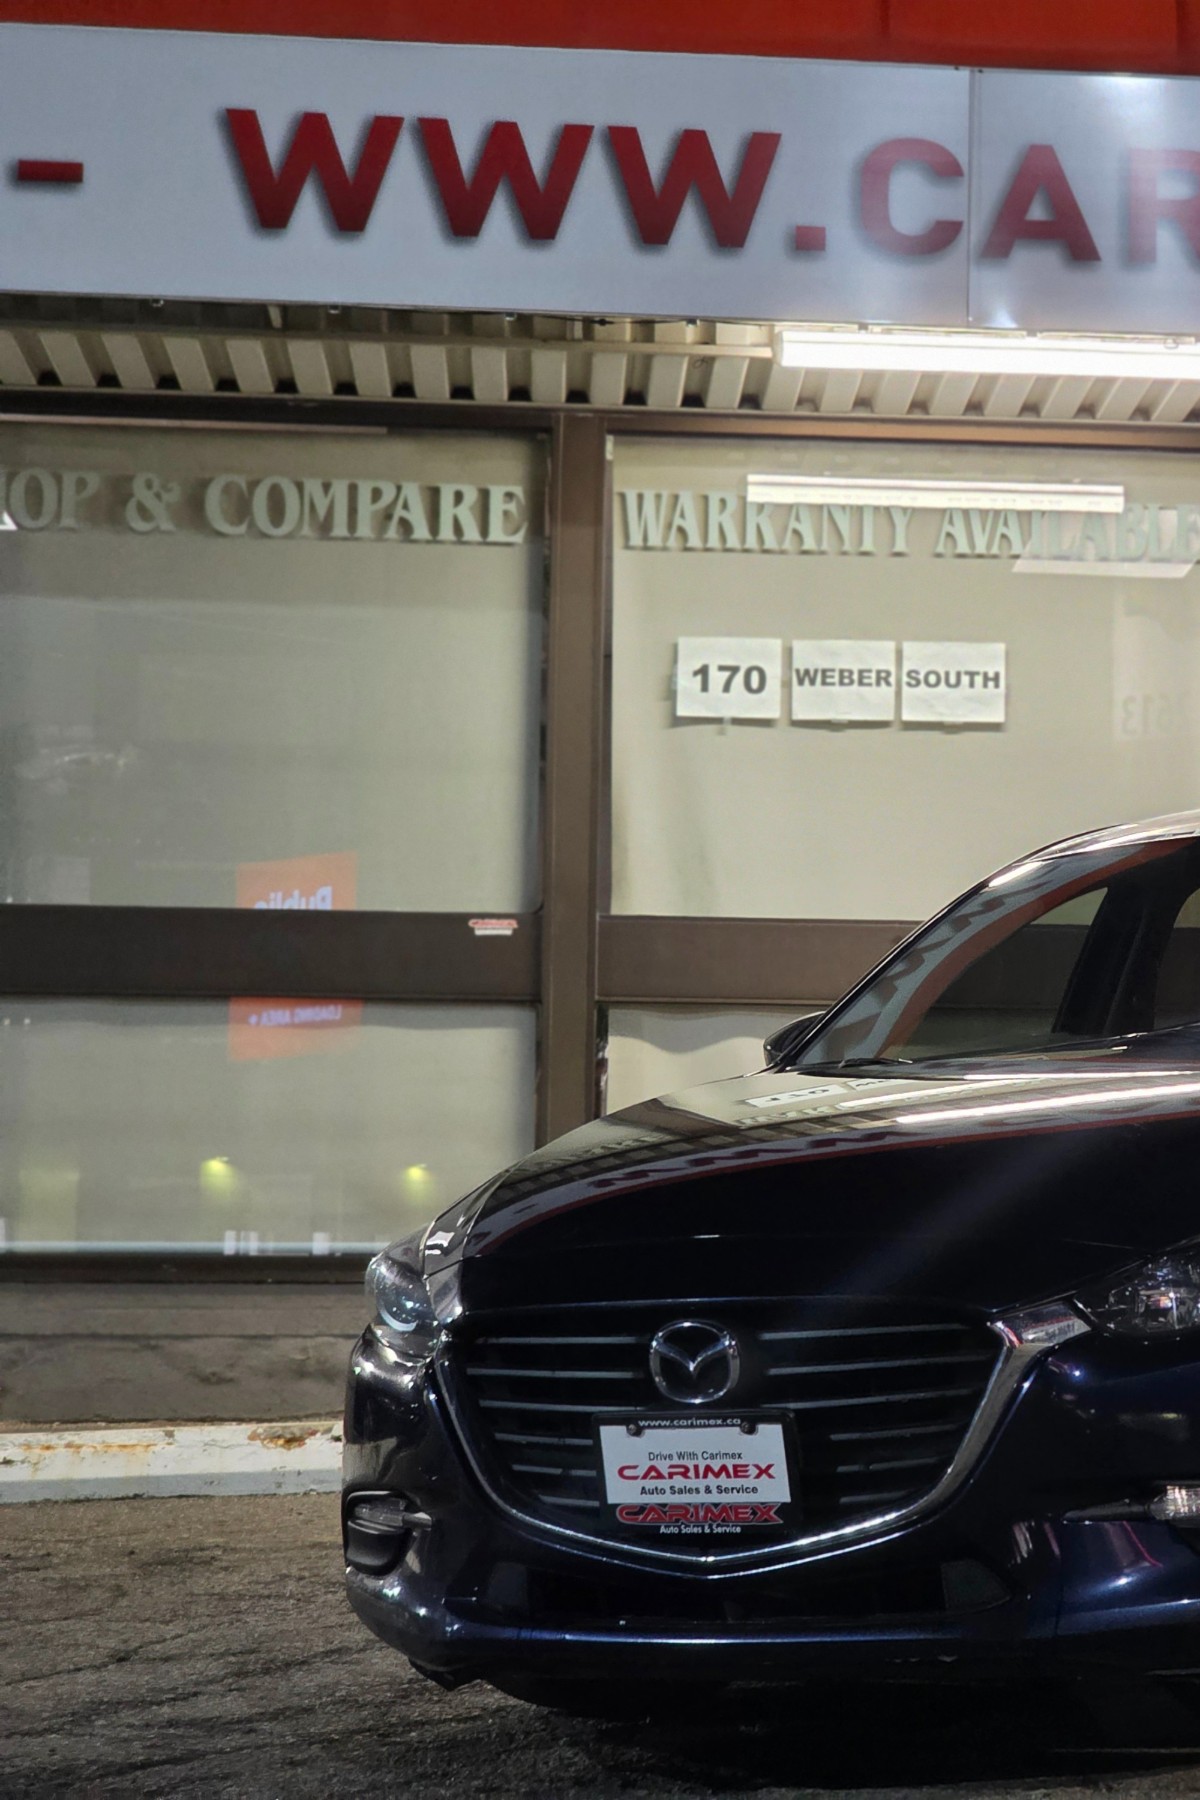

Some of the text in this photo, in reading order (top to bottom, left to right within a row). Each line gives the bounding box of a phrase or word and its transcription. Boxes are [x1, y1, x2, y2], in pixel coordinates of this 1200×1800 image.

[0, 465, 528, 544] OP & COMPARE
[616, 489, 912, 552] WARRANTY
[691, 663, 1001, 695] 170 WEBER SOUTH
[638, 1417, 742, 1427] www.carimex.ca
[647, 1450, 743, 1461] Drive With Carimex
[617, 1463, 776, 1481] CARIMEX
[640, 1484, 759, 1496] Auto Sales & Service
[616, 1503, 783, 1524] CARIMEX
[660, 1524, 742, 1534] Auto Sales & Service
